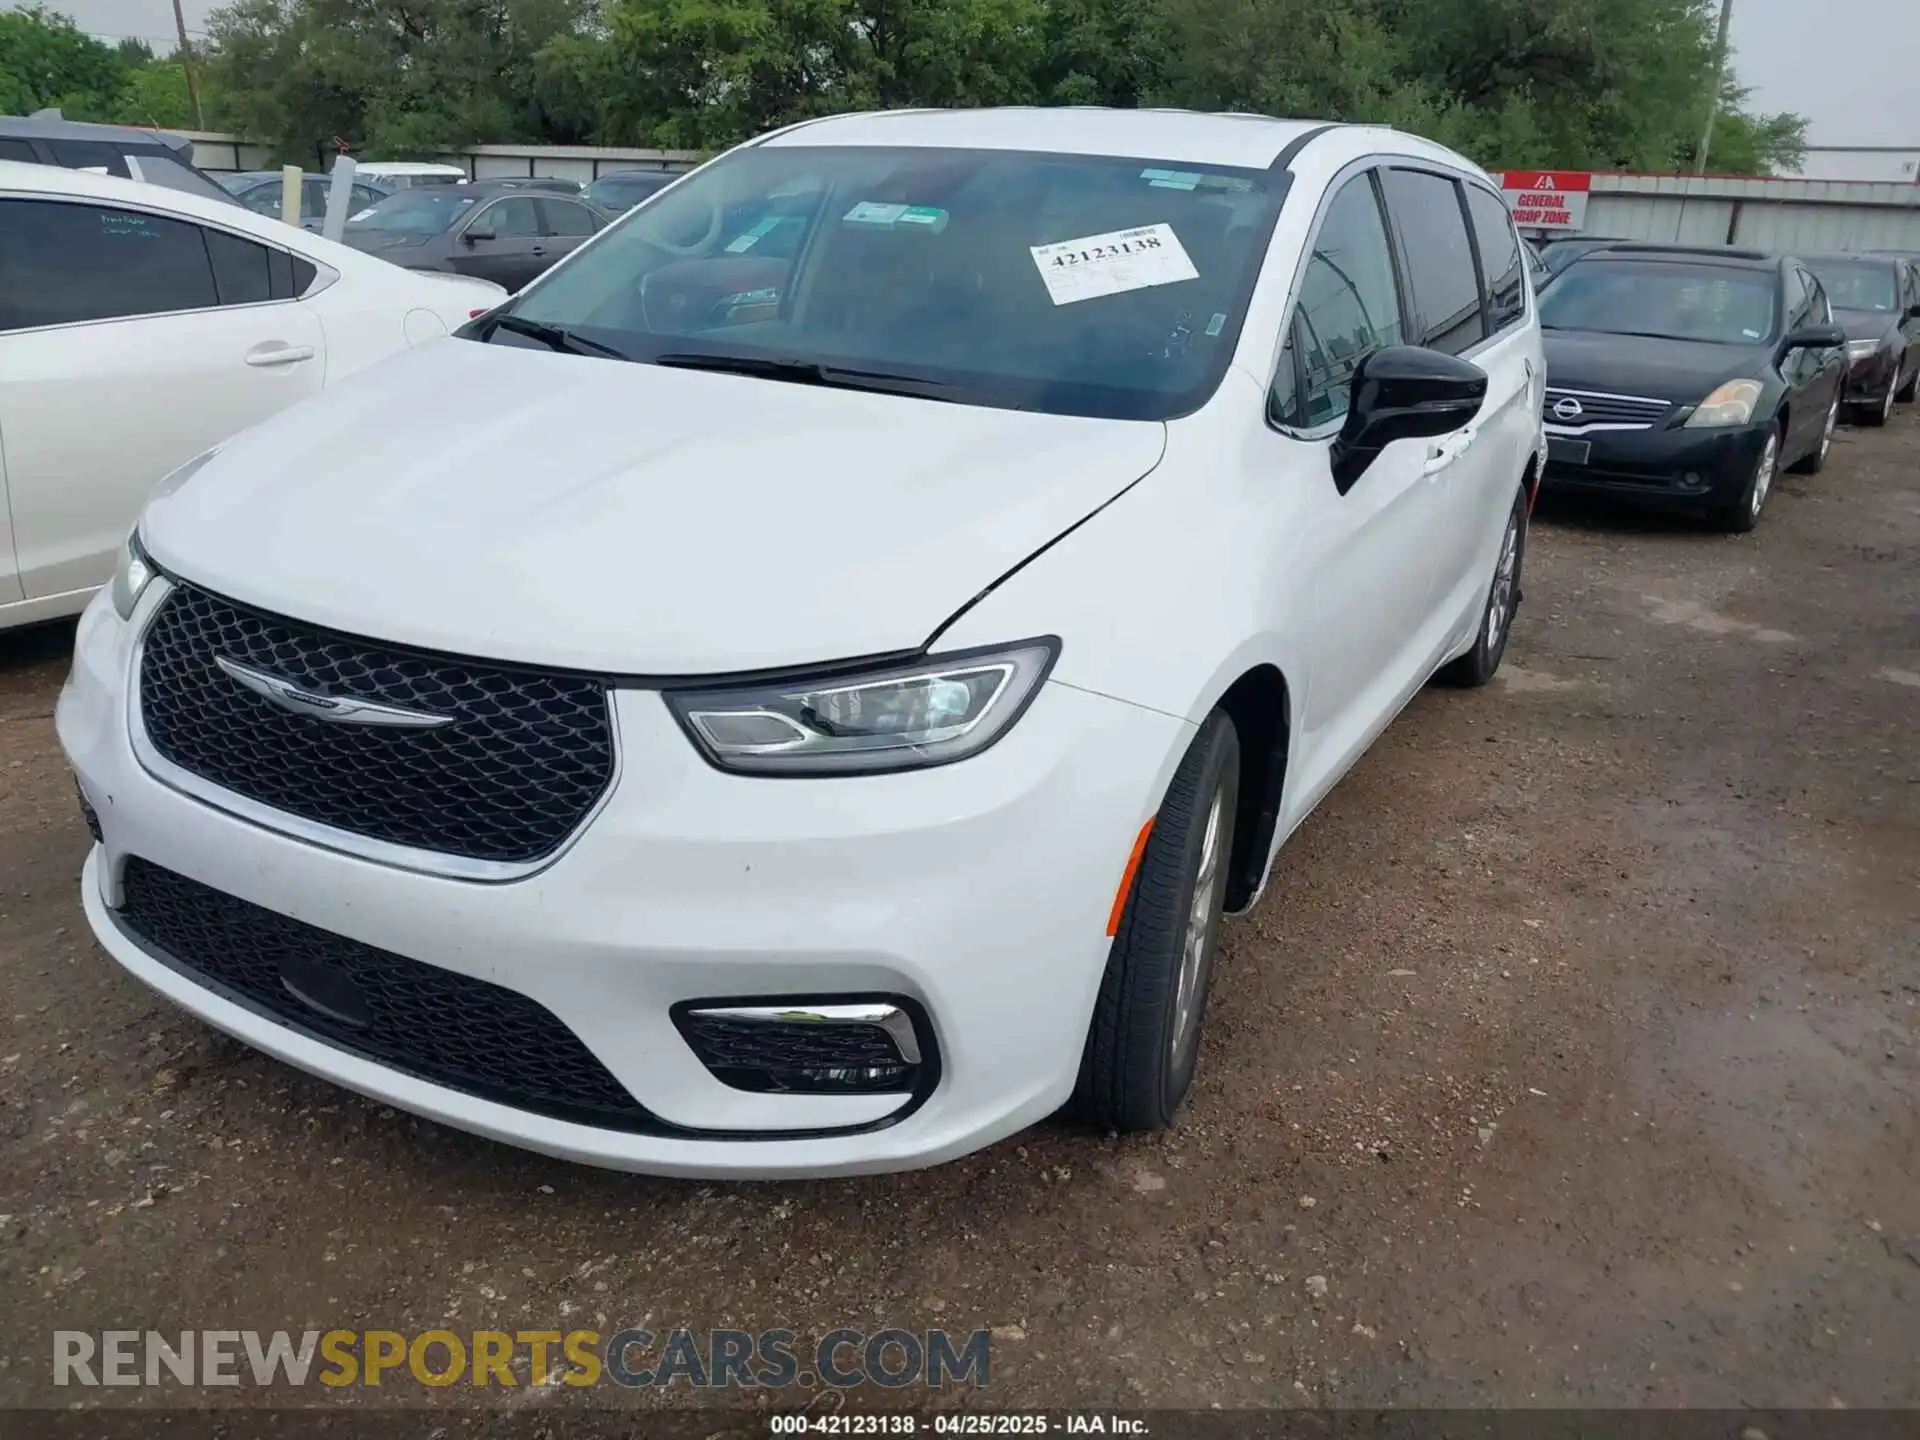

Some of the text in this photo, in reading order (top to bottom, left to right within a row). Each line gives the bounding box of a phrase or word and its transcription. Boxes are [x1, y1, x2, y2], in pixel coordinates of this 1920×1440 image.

[1518, 193, 1565, 208] GENERAL
[1542, 211, 1571, 224] ZONE
[1051, 238, 1161, 267] 42123138
